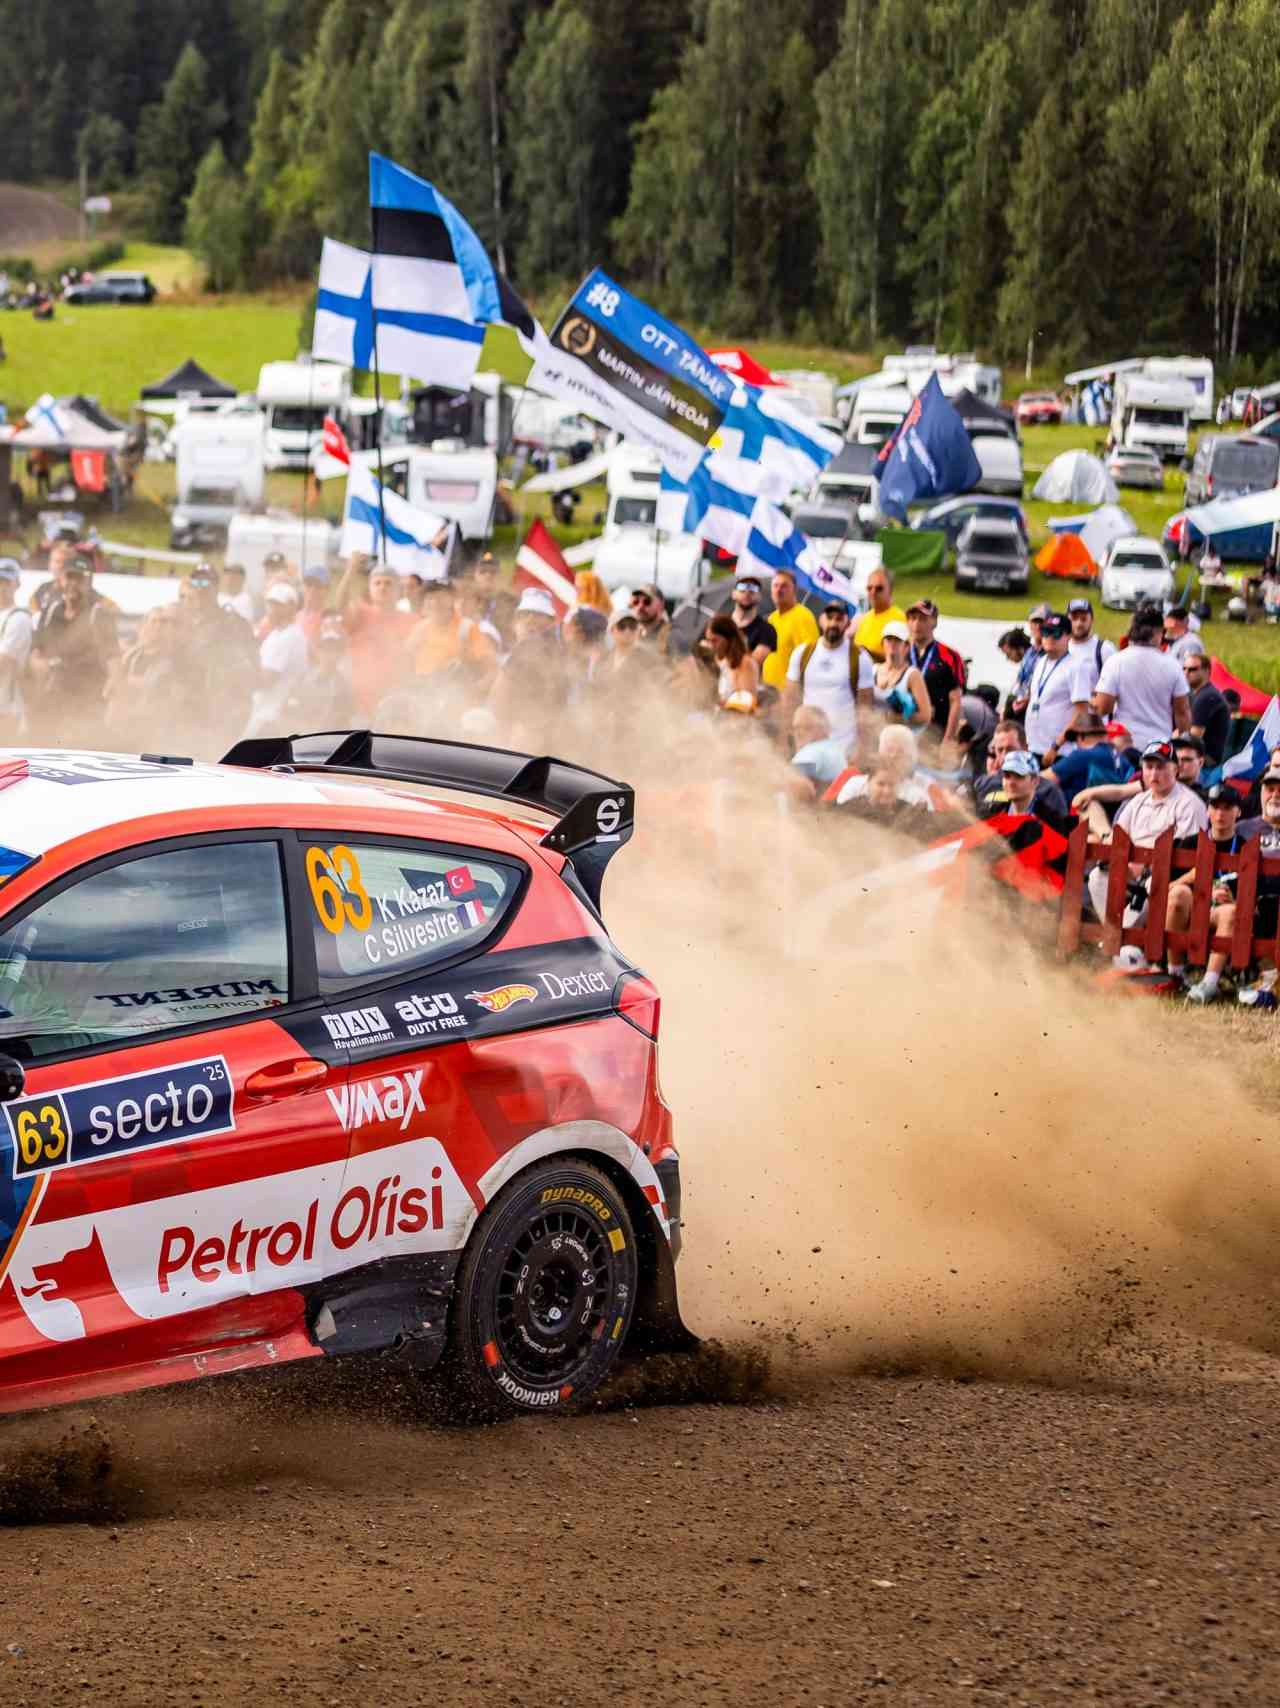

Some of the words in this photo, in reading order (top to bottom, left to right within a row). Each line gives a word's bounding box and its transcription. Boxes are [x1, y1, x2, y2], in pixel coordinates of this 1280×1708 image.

[585, 281, 621, 317] #8
[640, 323, 679, 357] OTT
[596, 348, 646, 389] MARTIN
[305, 845, 373, 935] 63
[375, 895, 396, 923] K
[394, 880, 450, 917] Kazaz
[364, 934, 381, 963] C
[381, 911, 460, 957] Silvestre
[537, 971, 611, 1000] Dexter
[323, 1007, 387, 1039] TAV
[407, 1020, 438, 1036] DUTY
[438, 1015, 469, 1030] FREE
[89, 1080, 215, 1146] secto
[16, 1105, 67, 1166] 63
[158, 1198, 320, 1293] Petrol
[329, 1166, 444, 1250] Ofisi
